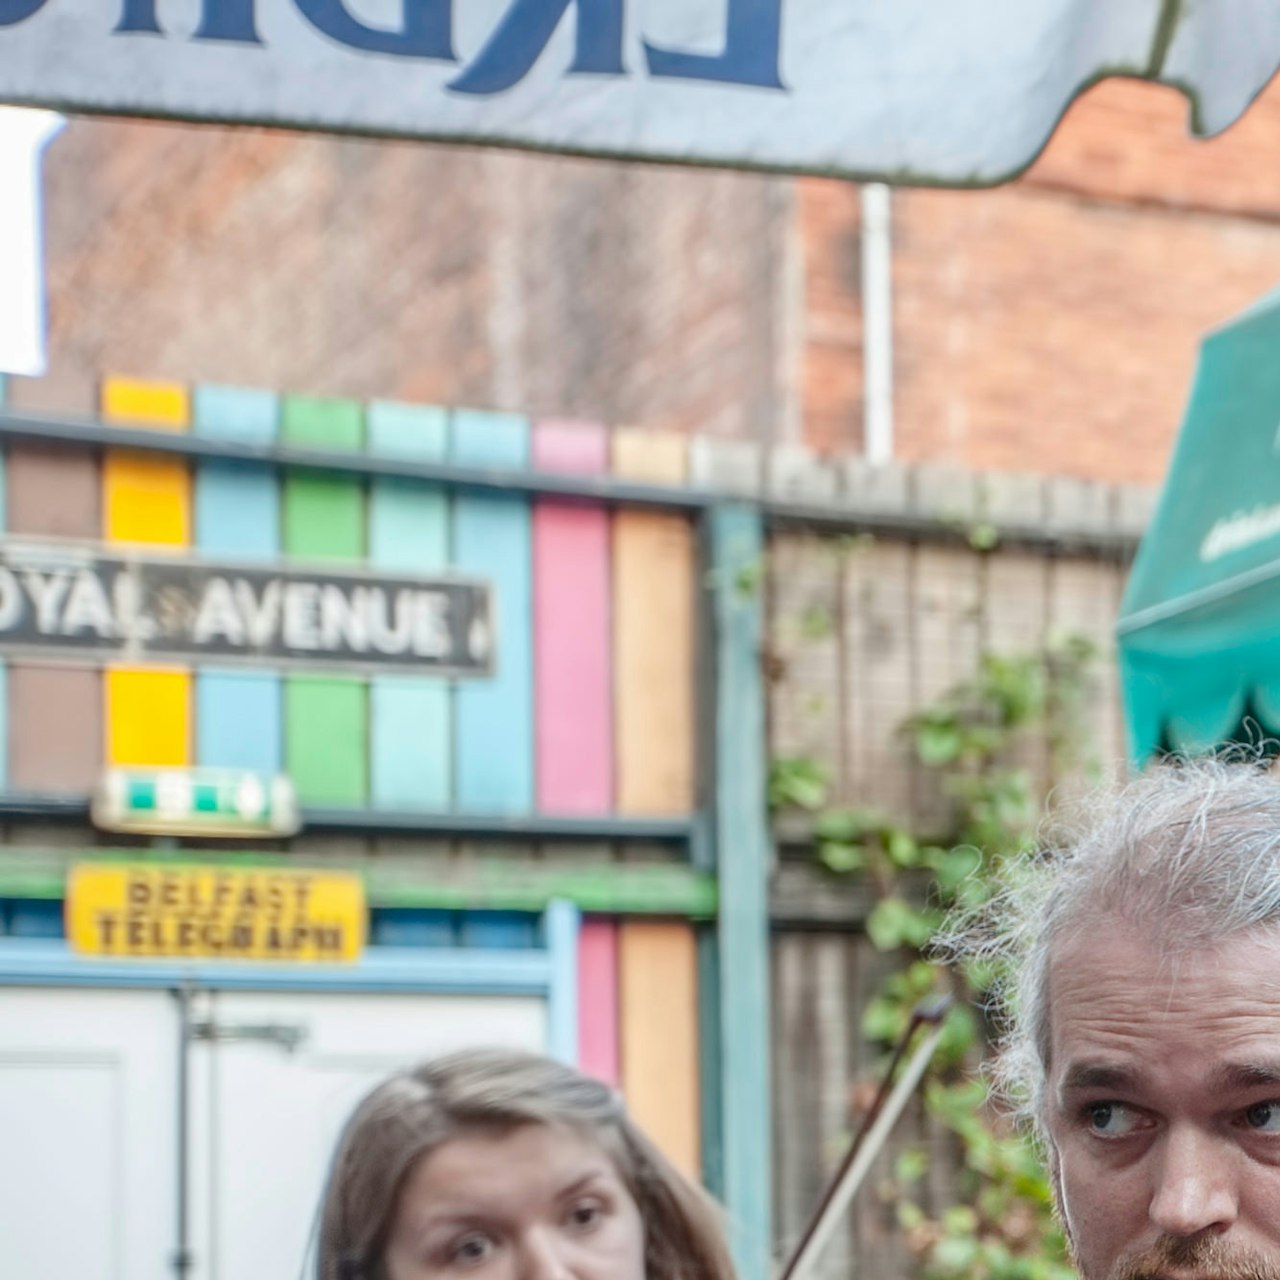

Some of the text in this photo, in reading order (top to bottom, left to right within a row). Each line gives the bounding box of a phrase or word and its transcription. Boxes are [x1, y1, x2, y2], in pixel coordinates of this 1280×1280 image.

[193, 576, 453, 659] AVENUE
[126, 874, 312, 912] BELFAST
[96, 913, 345, 954] TELEGRAPH
